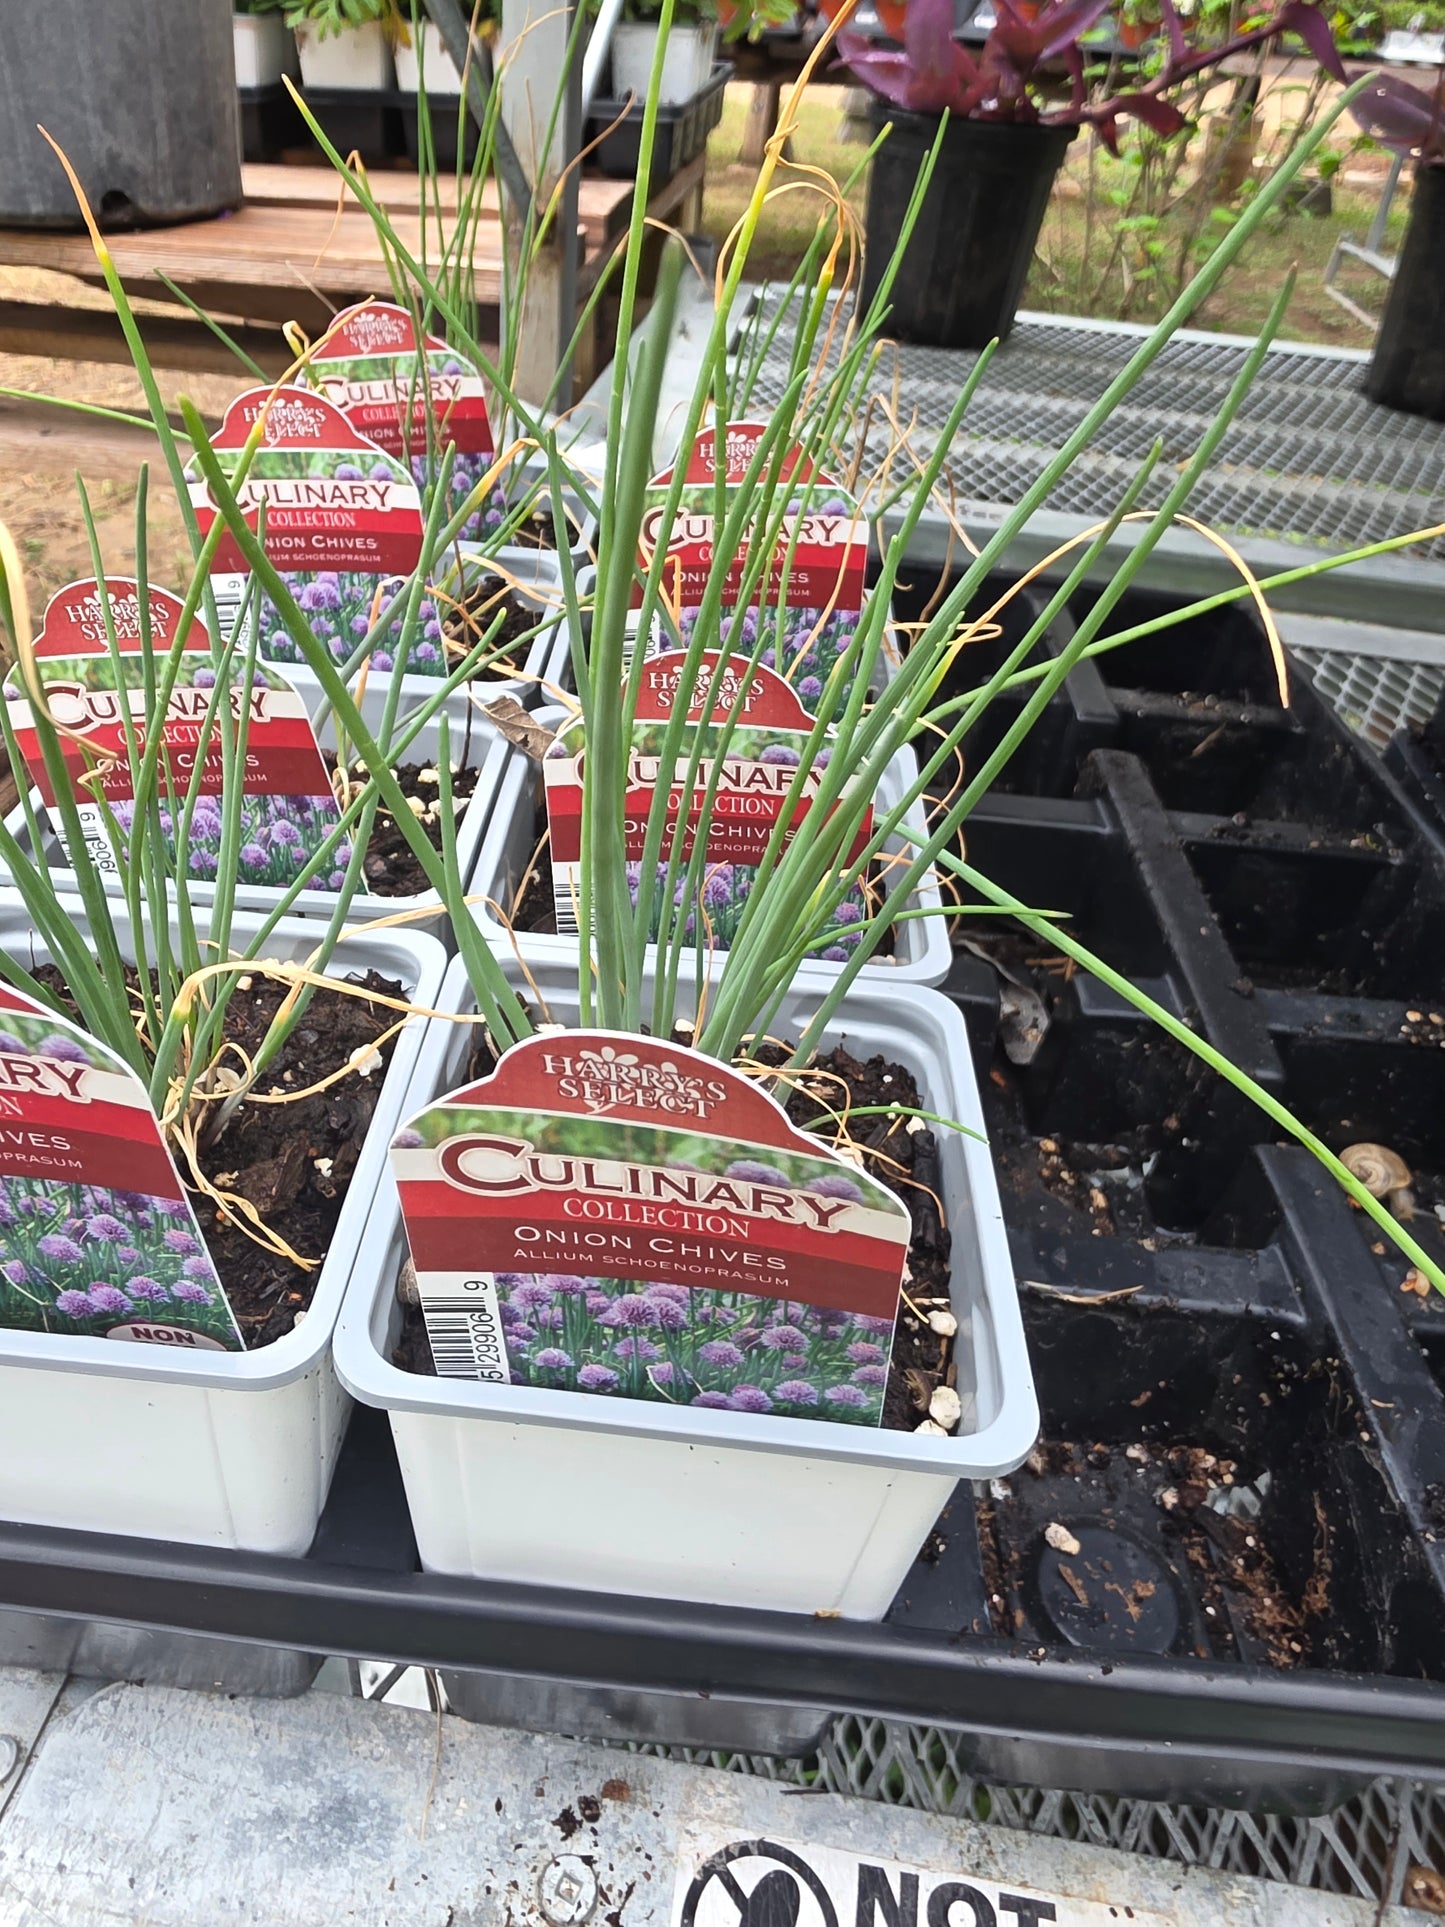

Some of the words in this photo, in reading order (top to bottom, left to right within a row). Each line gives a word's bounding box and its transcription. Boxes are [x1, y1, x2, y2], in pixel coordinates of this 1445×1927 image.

[267, 511, 356, 527] COLLECTION
[311, 535, 378, 549] CHIVES
[541, 1053, 727, 1102] HARRY'S
[558, 1078, 716, 1119] SELECT
[441, 1138, 850, 1229] CULINARY
[562, 1197, 750, 1239] COLLECTION
[512, 1247, 594, 1263] ALLIUM
[602, 1254, 790, 1287] SCHOENOPRASUM
[513, 1225, 632, 1251] ONION
[648, 1237, 787, 1271] CHIVES
[130, 1326, 197, 1346] NON
